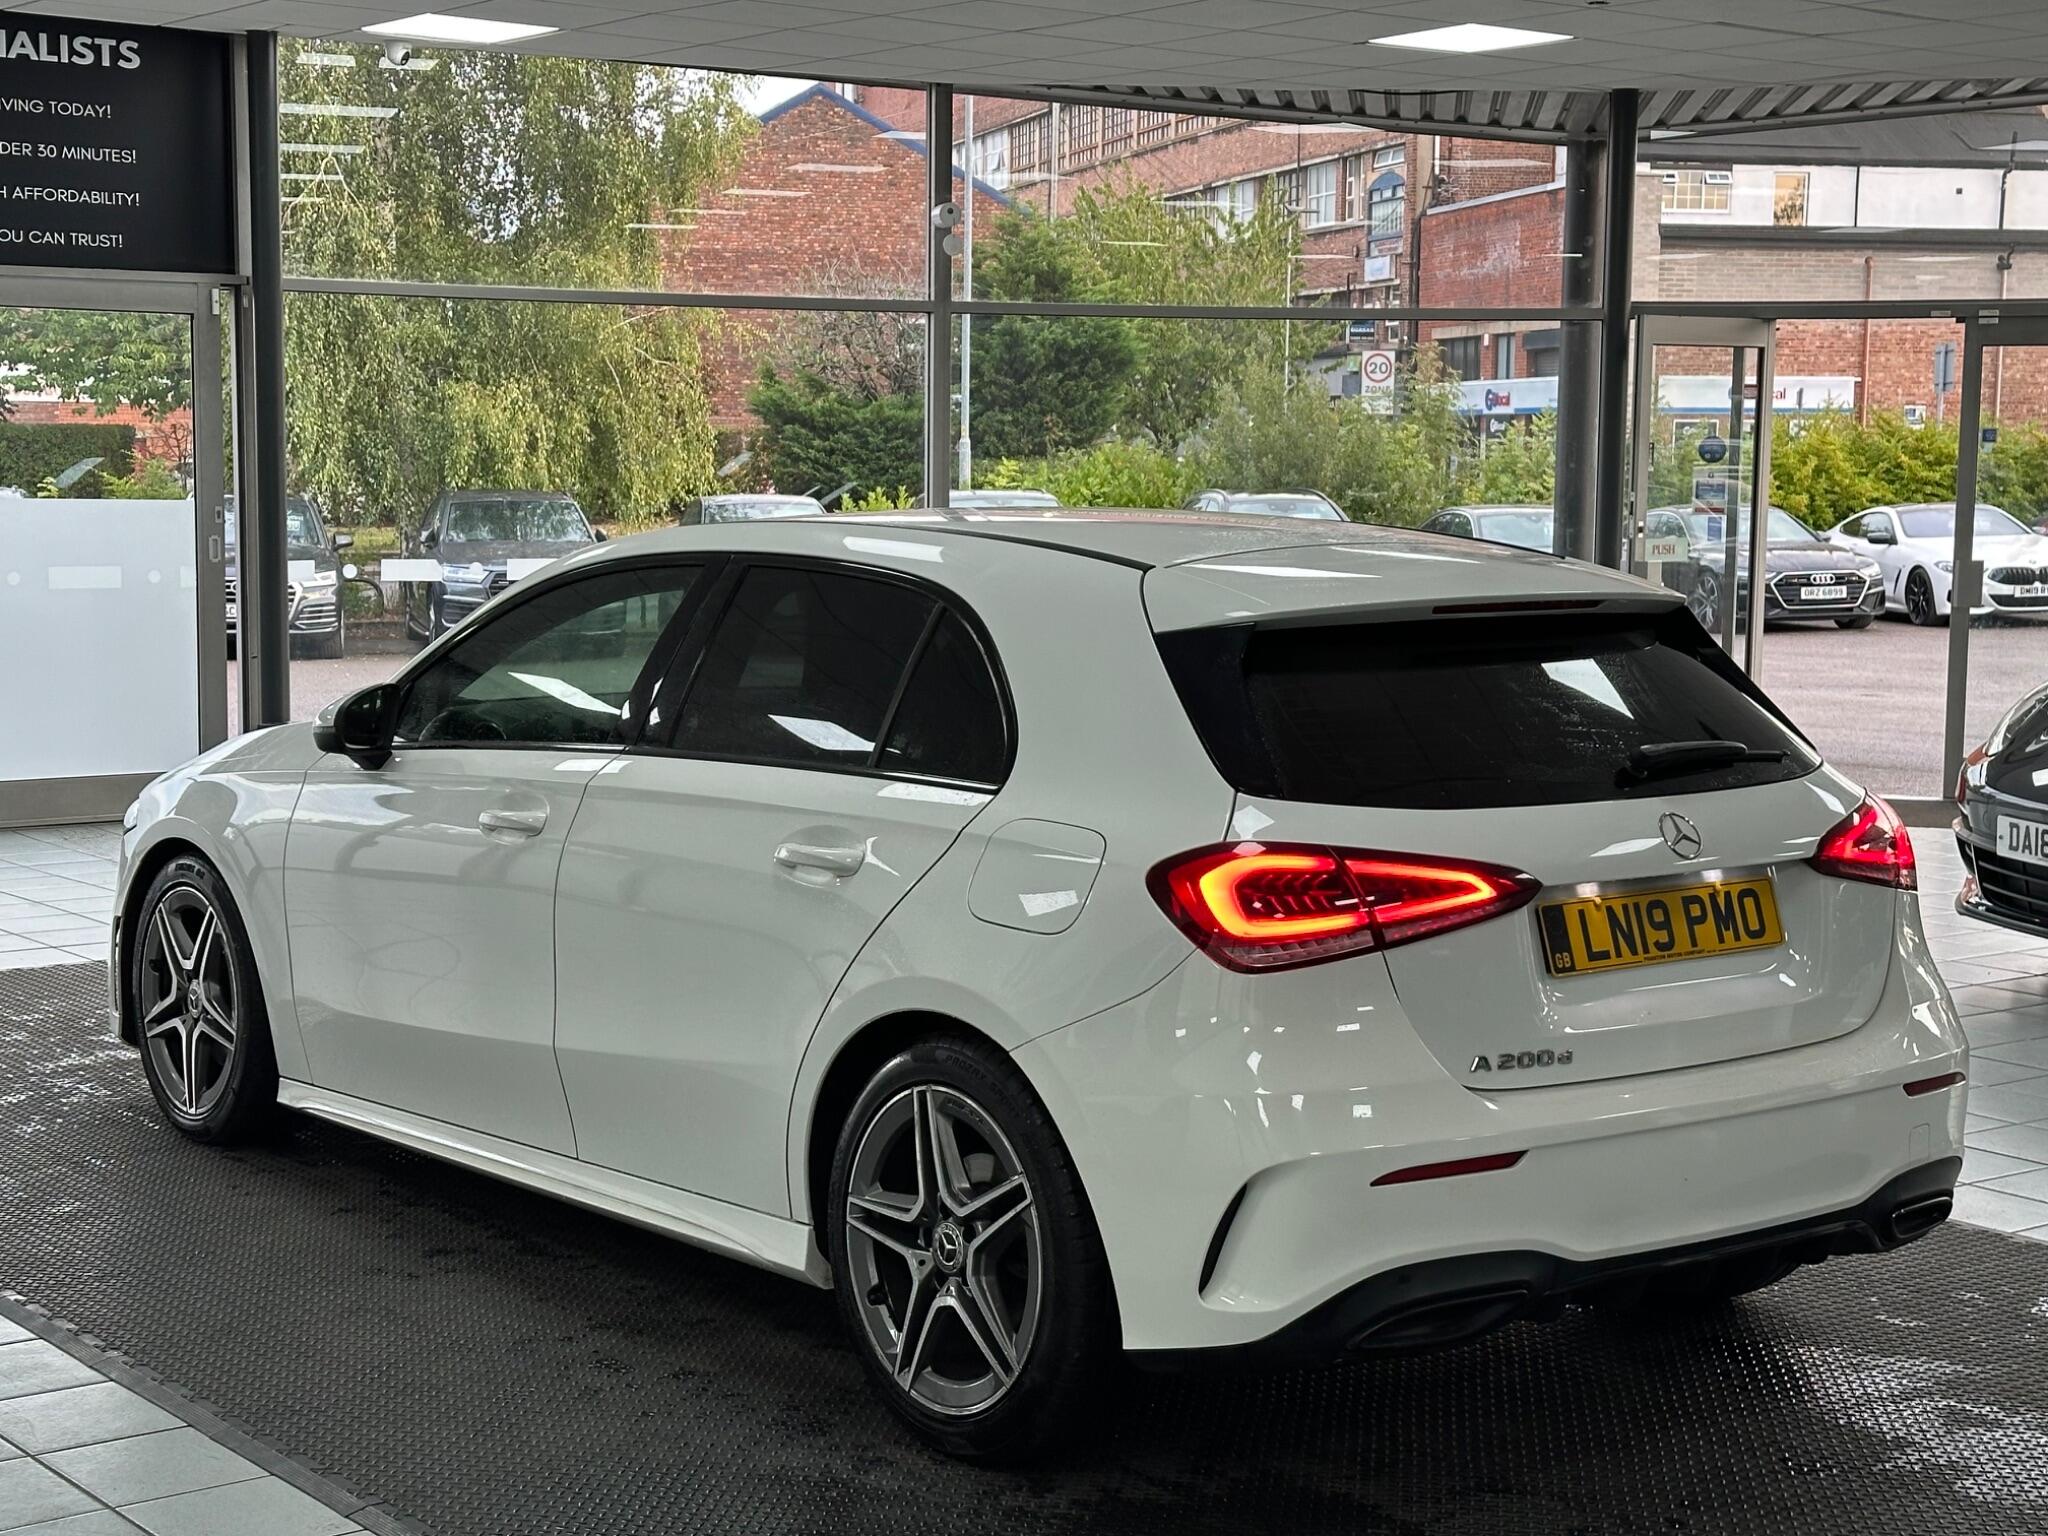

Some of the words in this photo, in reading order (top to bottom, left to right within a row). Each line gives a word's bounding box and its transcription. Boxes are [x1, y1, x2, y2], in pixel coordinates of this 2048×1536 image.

[49, 101, 112, 119] TODAY!
[38, 144, 57, 159] 30
[61, 146, 137, 164] MINUTES!
[12, 186, 140, 207] AFFORDABILITY!
[28, 230, 65, 246] CAN
[69, 232, 123, 248] TRUST!
[1369, 362, 1388, 374] 20
[1652, 544, 1675, 555] PUSH
[2008, 821, 2048, 858] DA18
[1578, 899, 1675, 962] LN19
[1681, 887, 1767, 949] PMO
[1555, 952, 1571, 969] GB
[1469, 1055, 1492, 1073] A
